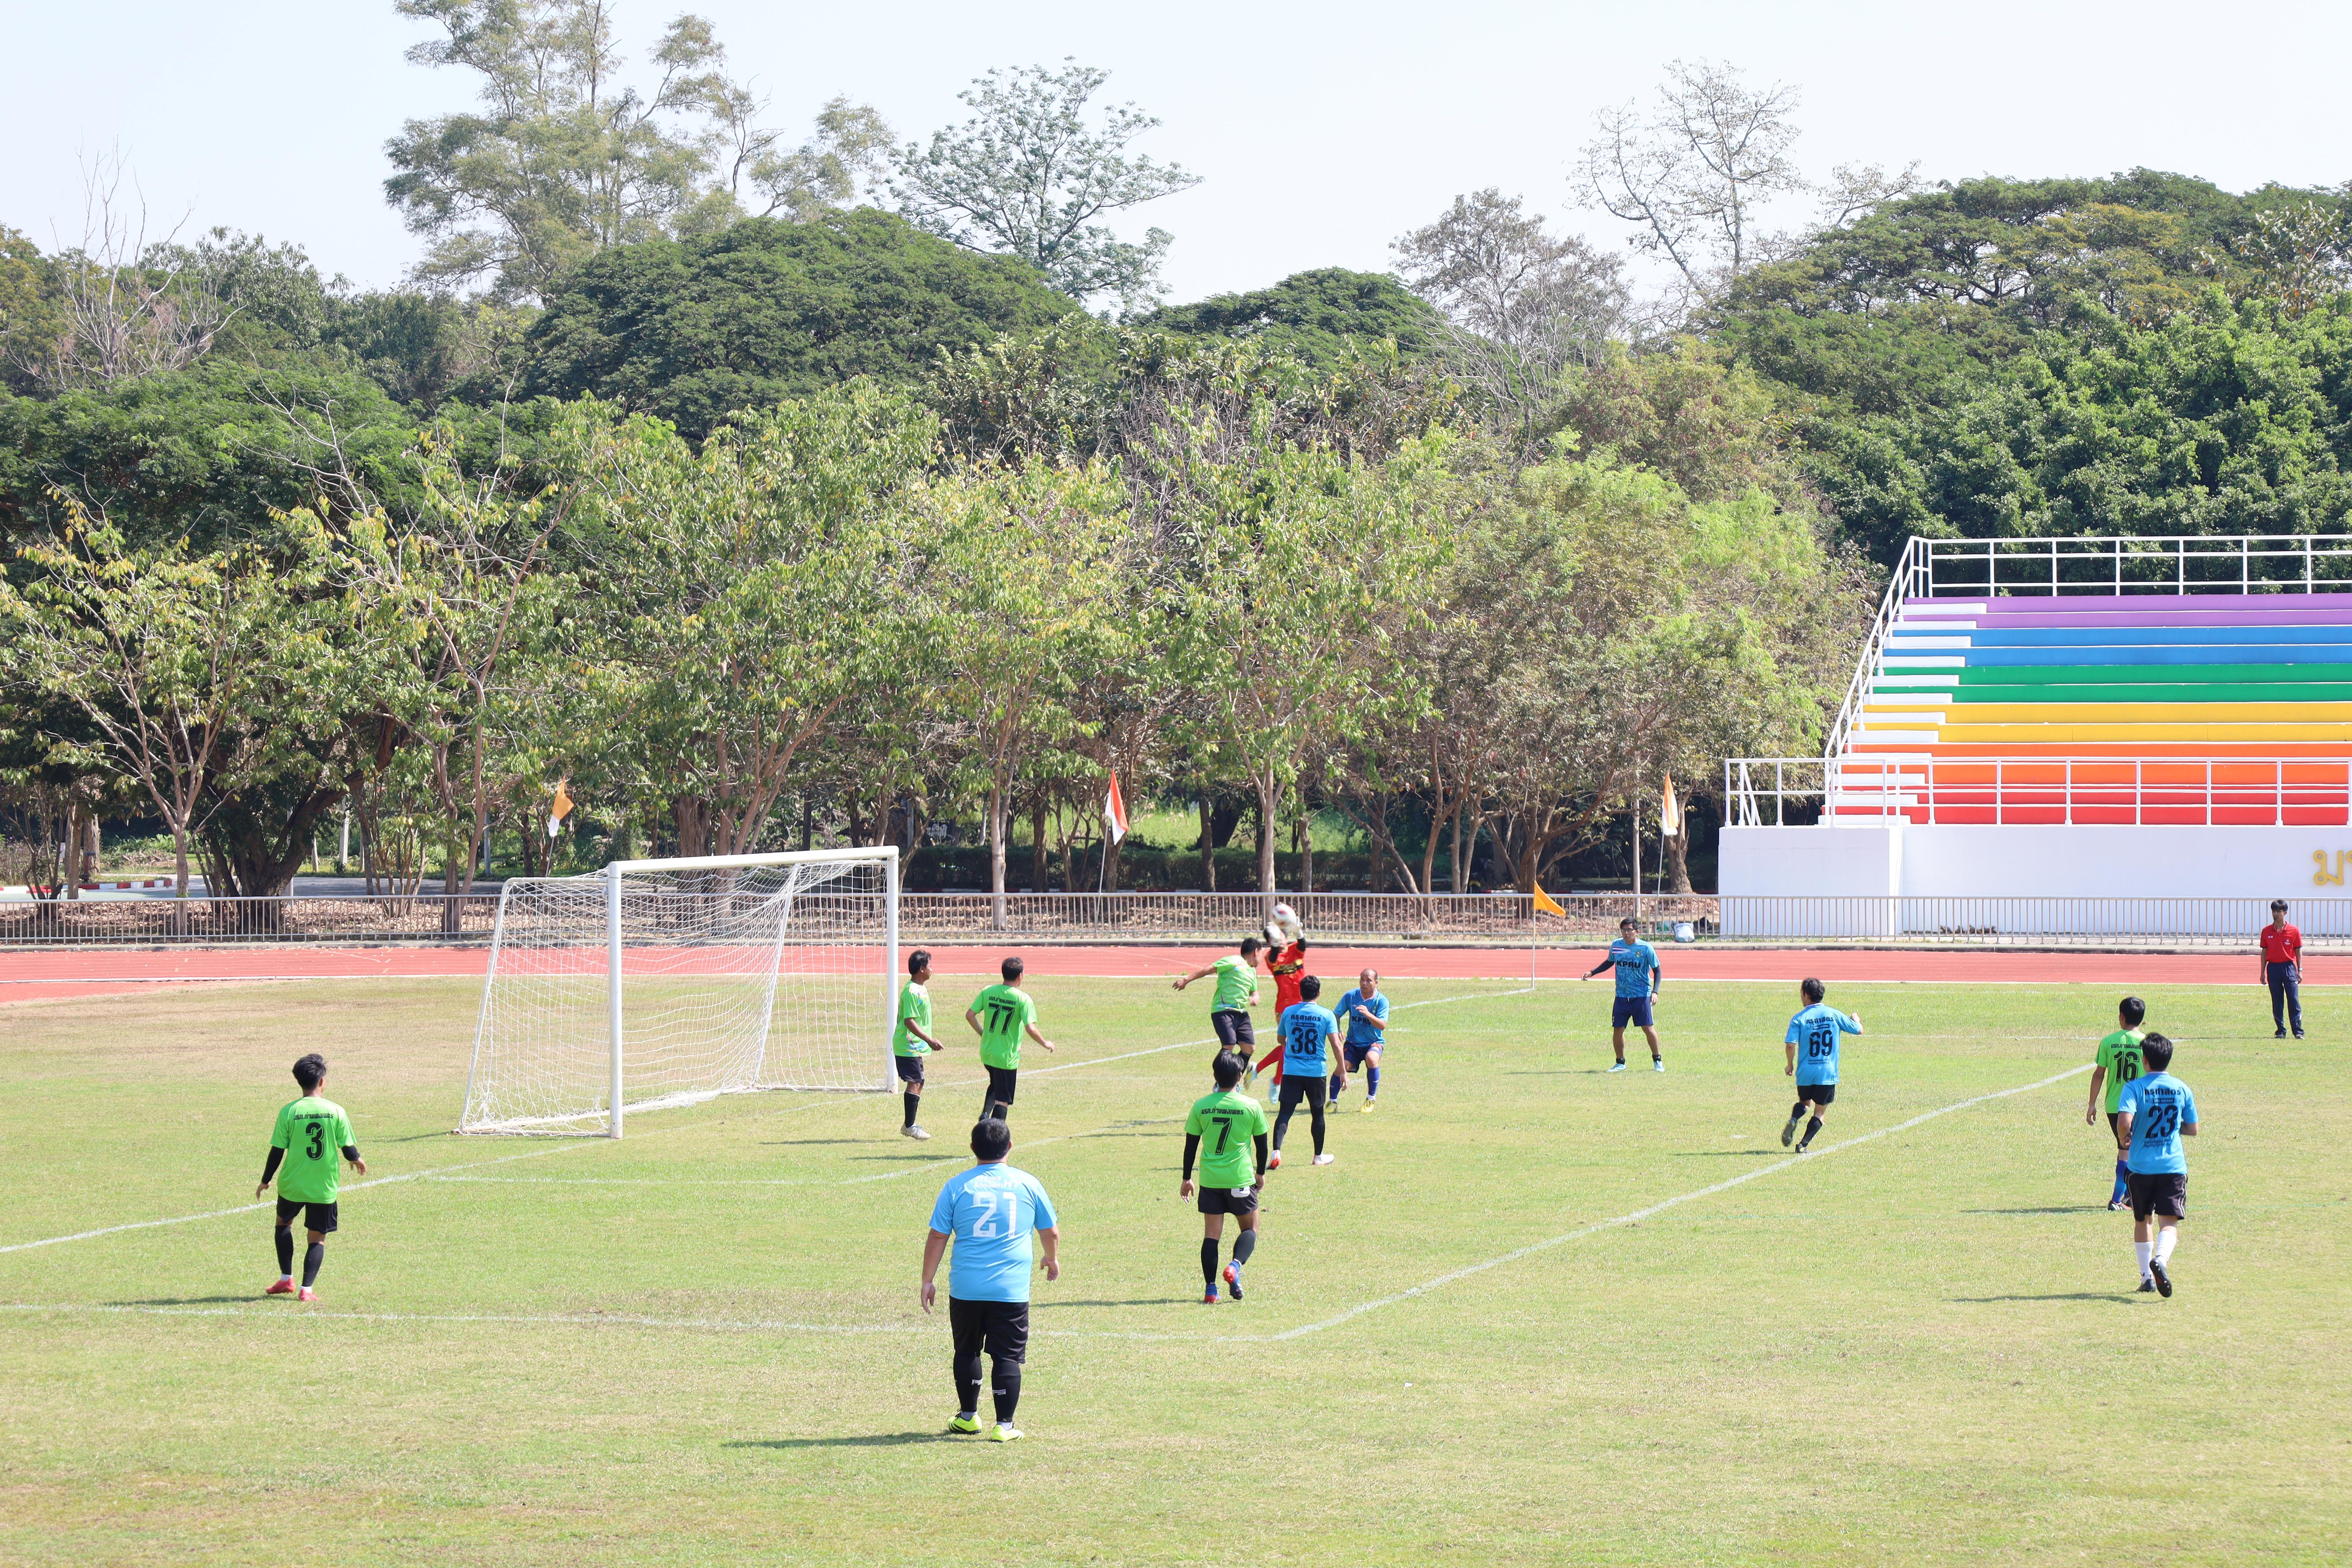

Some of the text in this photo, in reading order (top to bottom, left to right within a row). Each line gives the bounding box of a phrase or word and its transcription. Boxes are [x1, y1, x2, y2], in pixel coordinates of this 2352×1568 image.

[2313, 850, 2352, 885] ม
[1617, 960, 1641, 968] KPRU
[989, 1002, 1015, 1036] 77
[1291, 1027, 1318, 1055] 38
[1810, 1030, 1833, 1057] 69
[2114, 1051, 2139, 1084] 16
[1212, 1117, 1232, 1155] 7
[2145, 1105, 2178, 1138] 23
[306, 1122, 324, 1161] 3
[973, 1191, 1016, 1238] 21
